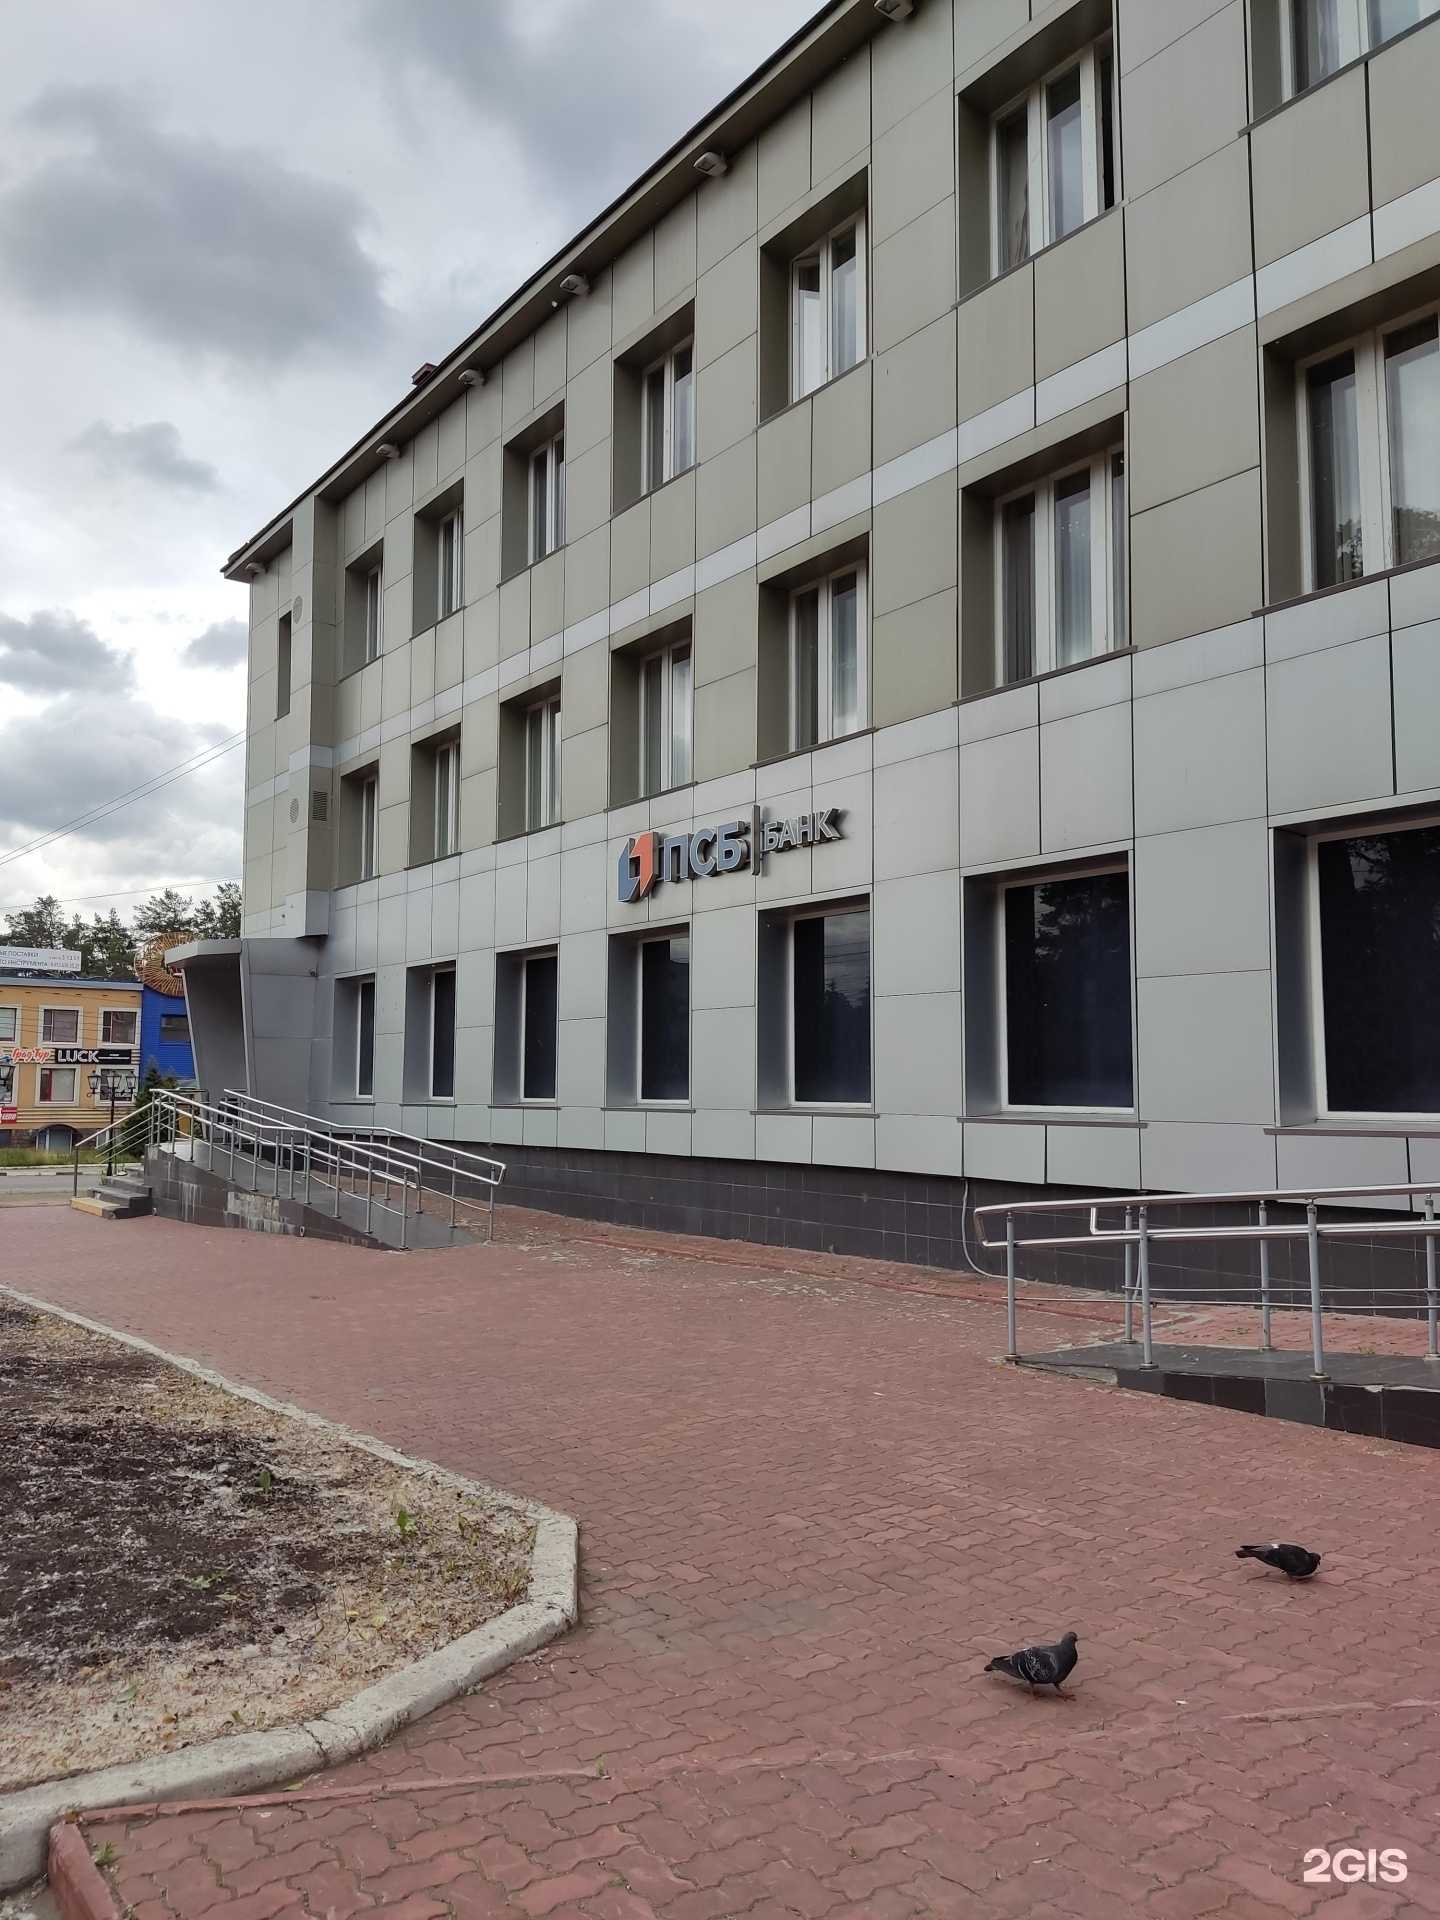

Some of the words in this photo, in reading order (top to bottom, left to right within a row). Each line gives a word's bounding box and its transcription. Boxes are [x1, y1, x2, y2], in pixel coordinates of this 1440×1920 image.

[663, 820, 745, 882] ПСБ
[763, 808, 843, 852] БАНК
[57, 1049, 99, 1063] LUCK
